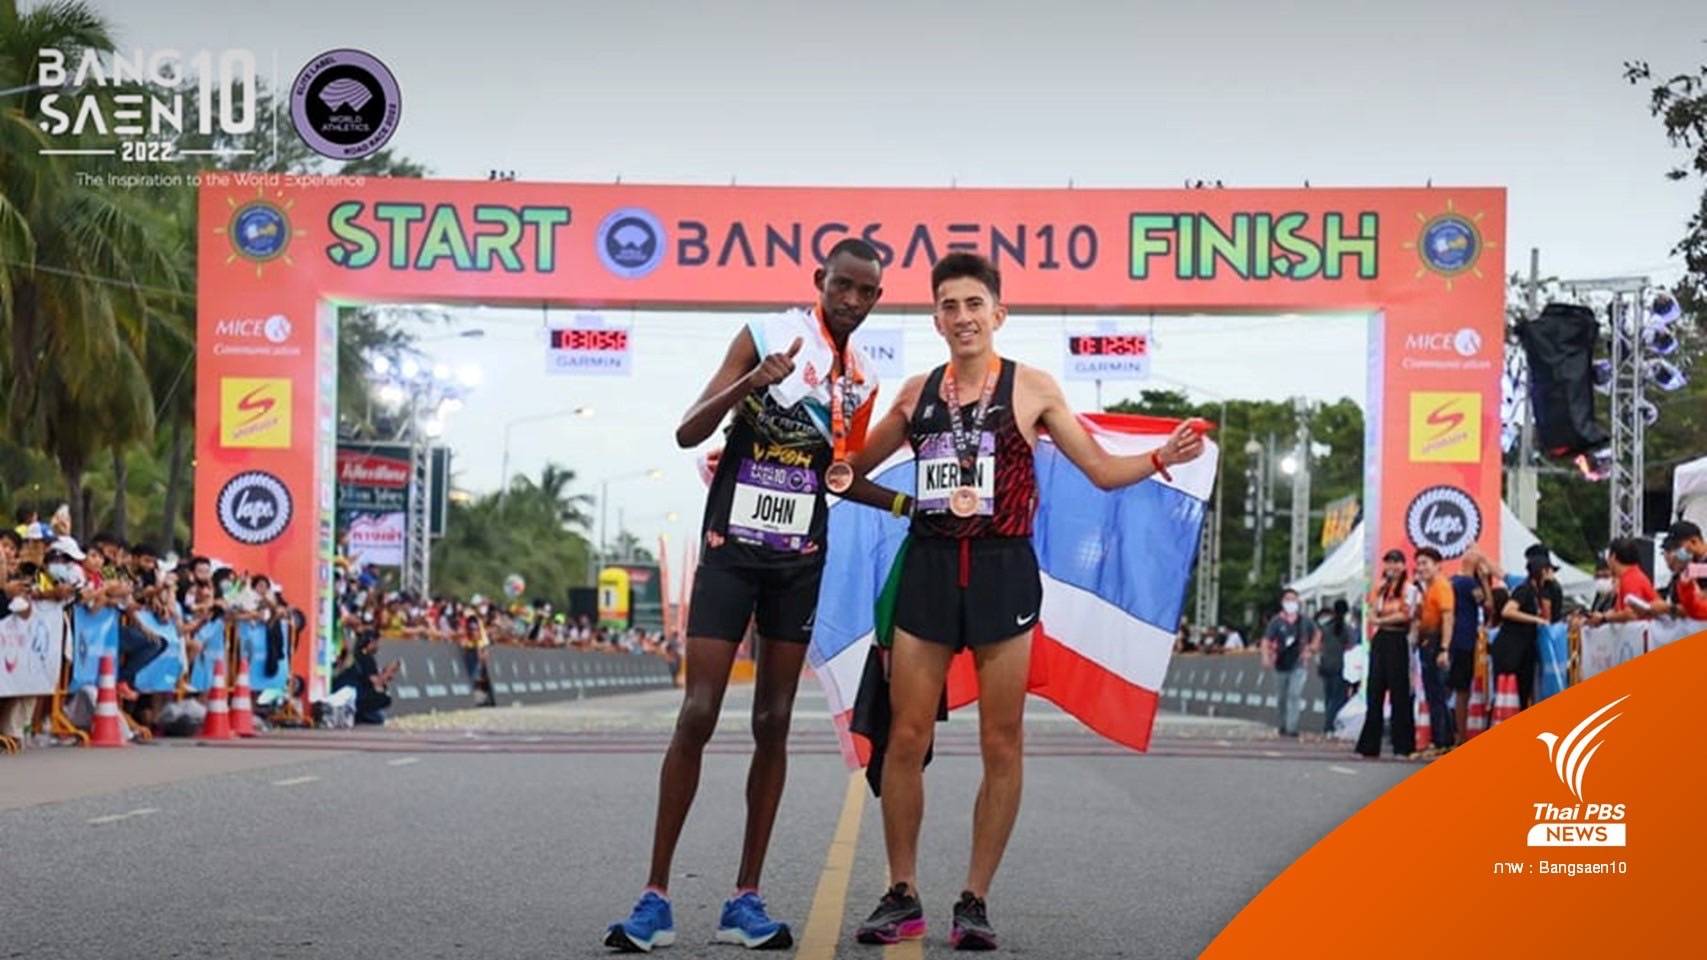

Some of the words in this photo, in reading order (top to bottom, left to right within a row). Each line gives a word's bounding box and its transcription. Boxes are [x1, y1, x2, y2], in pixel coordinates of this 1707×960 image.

[327, 200, 571, 273] START
[1129, 211, 1379, 281] FINISH
[926, 462, 984, 491] KIERN
[751, 493, 796, 525] JOHN
